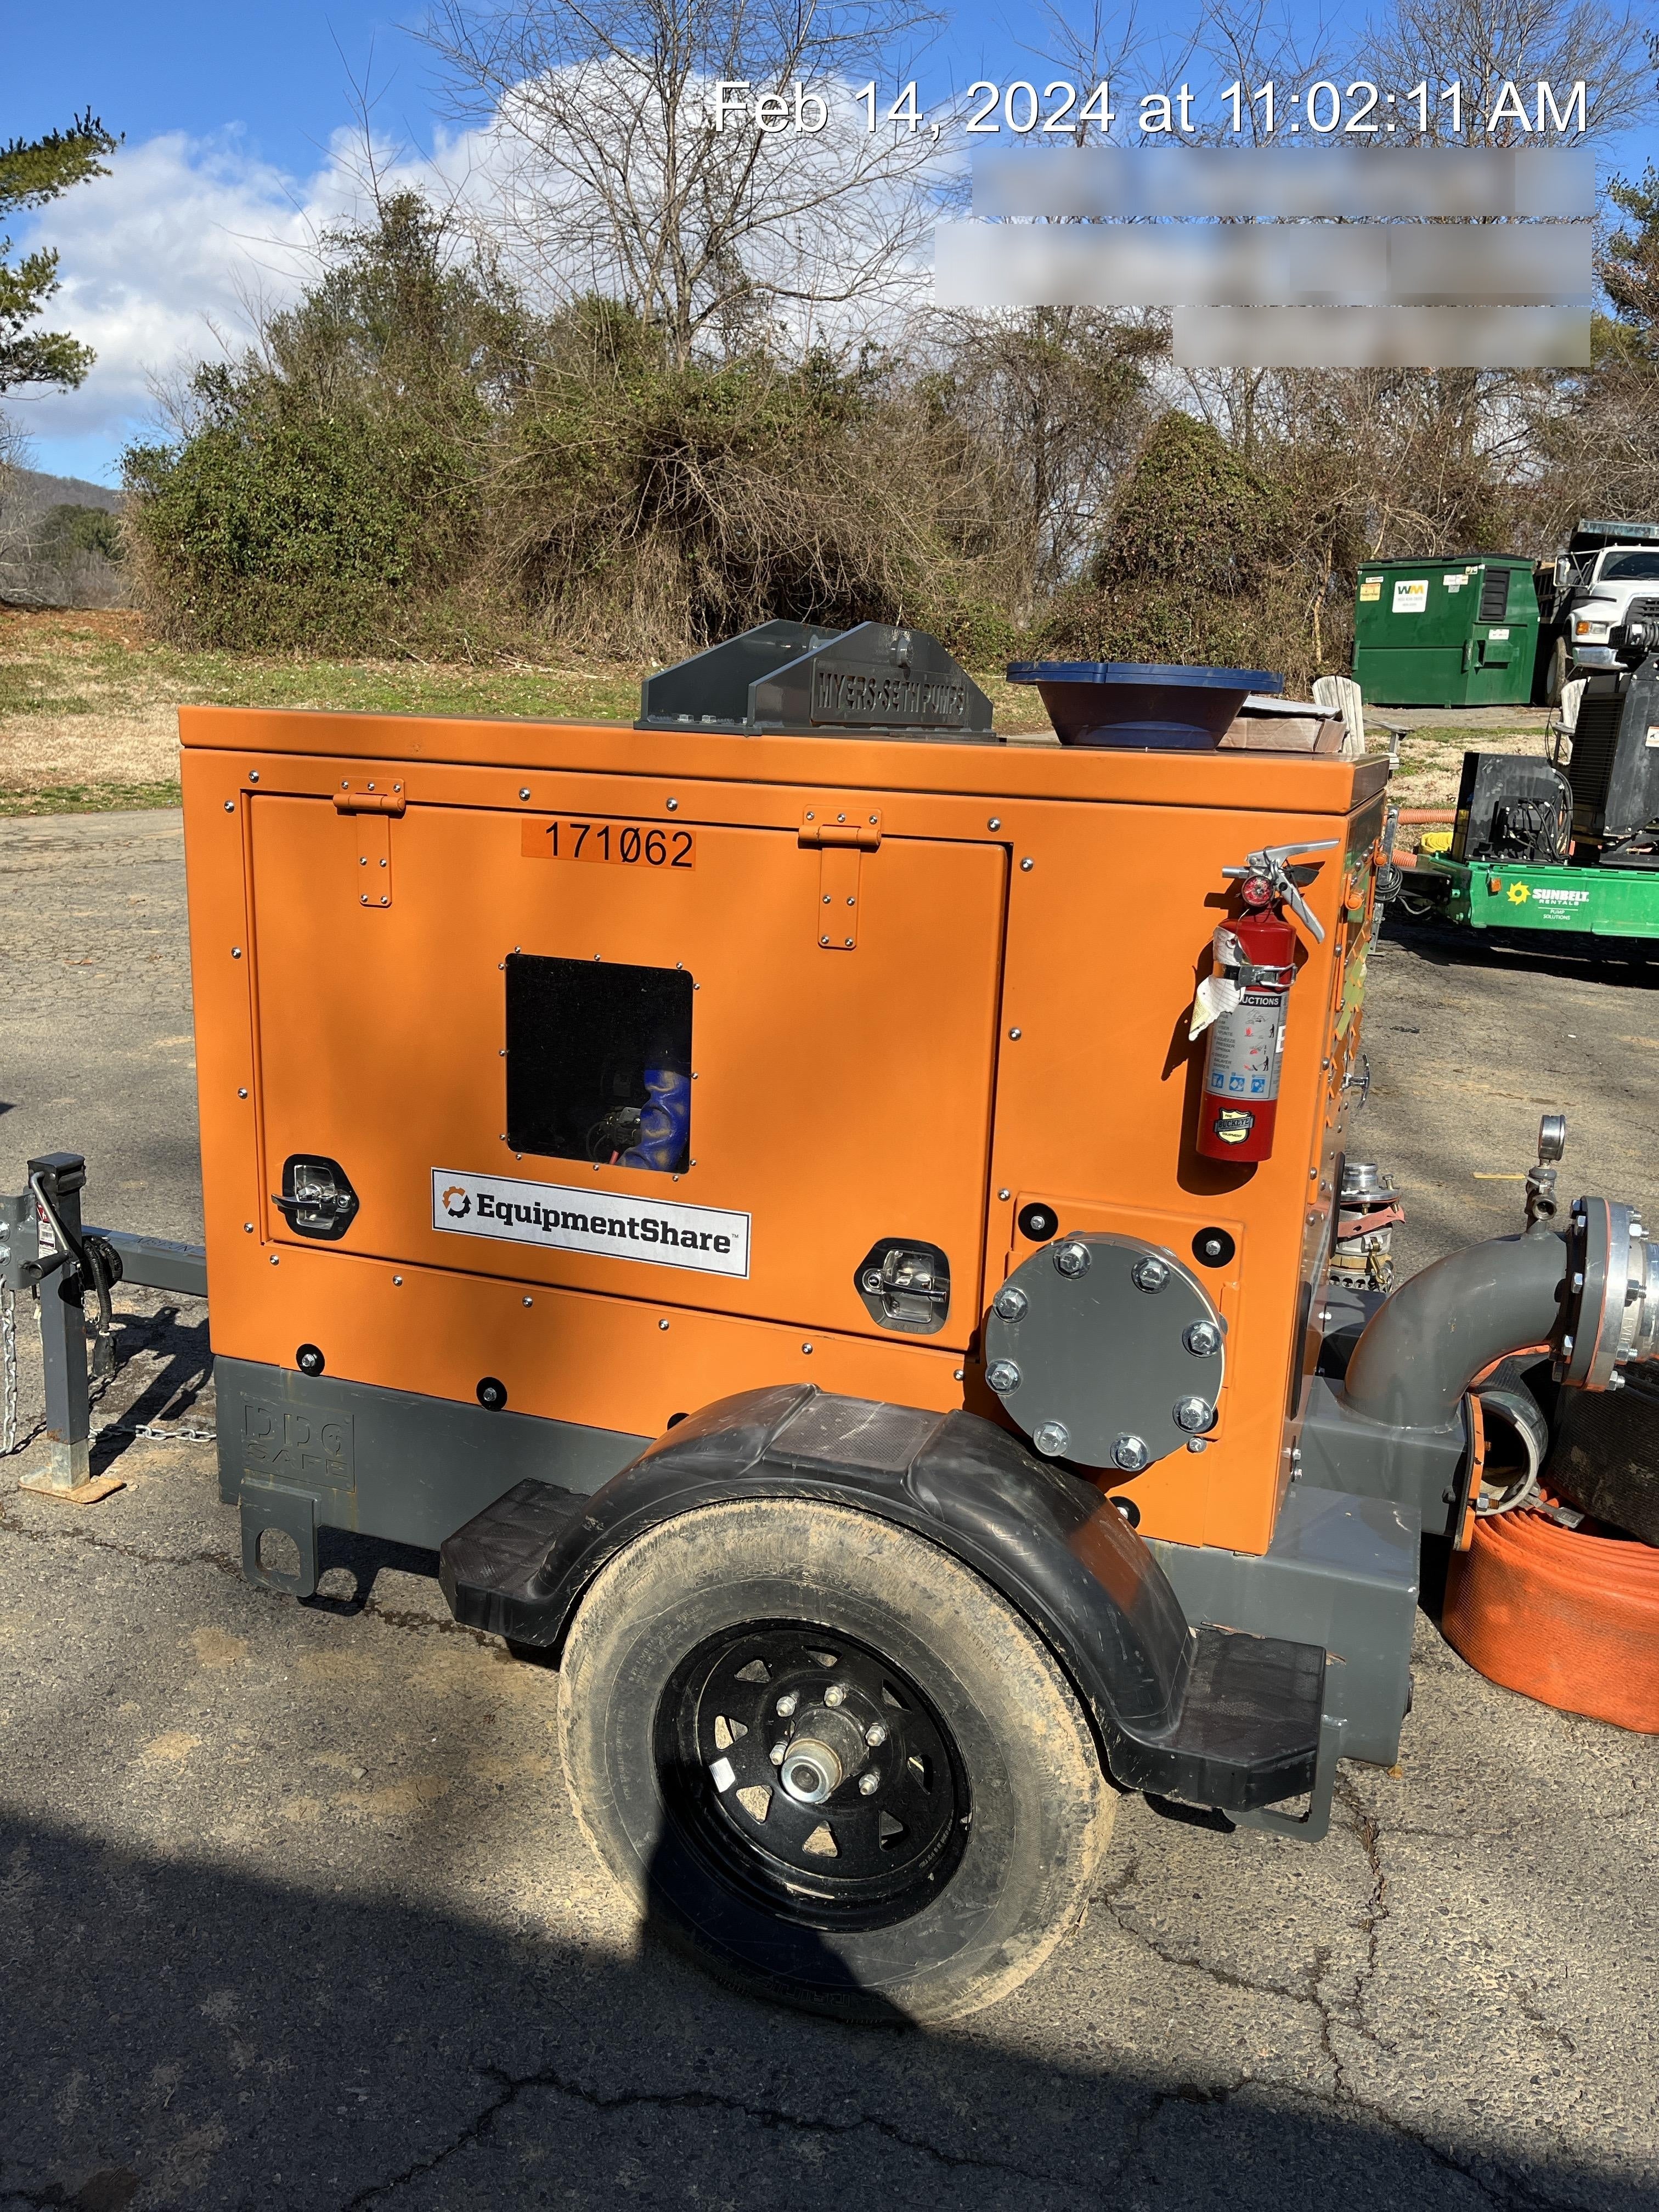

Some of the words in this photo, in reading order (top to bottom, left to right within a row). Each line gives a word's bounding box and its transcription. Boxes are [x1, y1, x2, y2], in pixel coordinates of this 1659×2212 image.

[1398, 585, 1424, 595] WM
[922, 683, 966, 716] PUMPS
[545, 821, 692, 868] 171062
[1532, 889, 1589, 901] SUNBELT
[1218, 1118, 1250, 1128] BUCKEYE
[246, 1442, 349, 1480] SAFE
